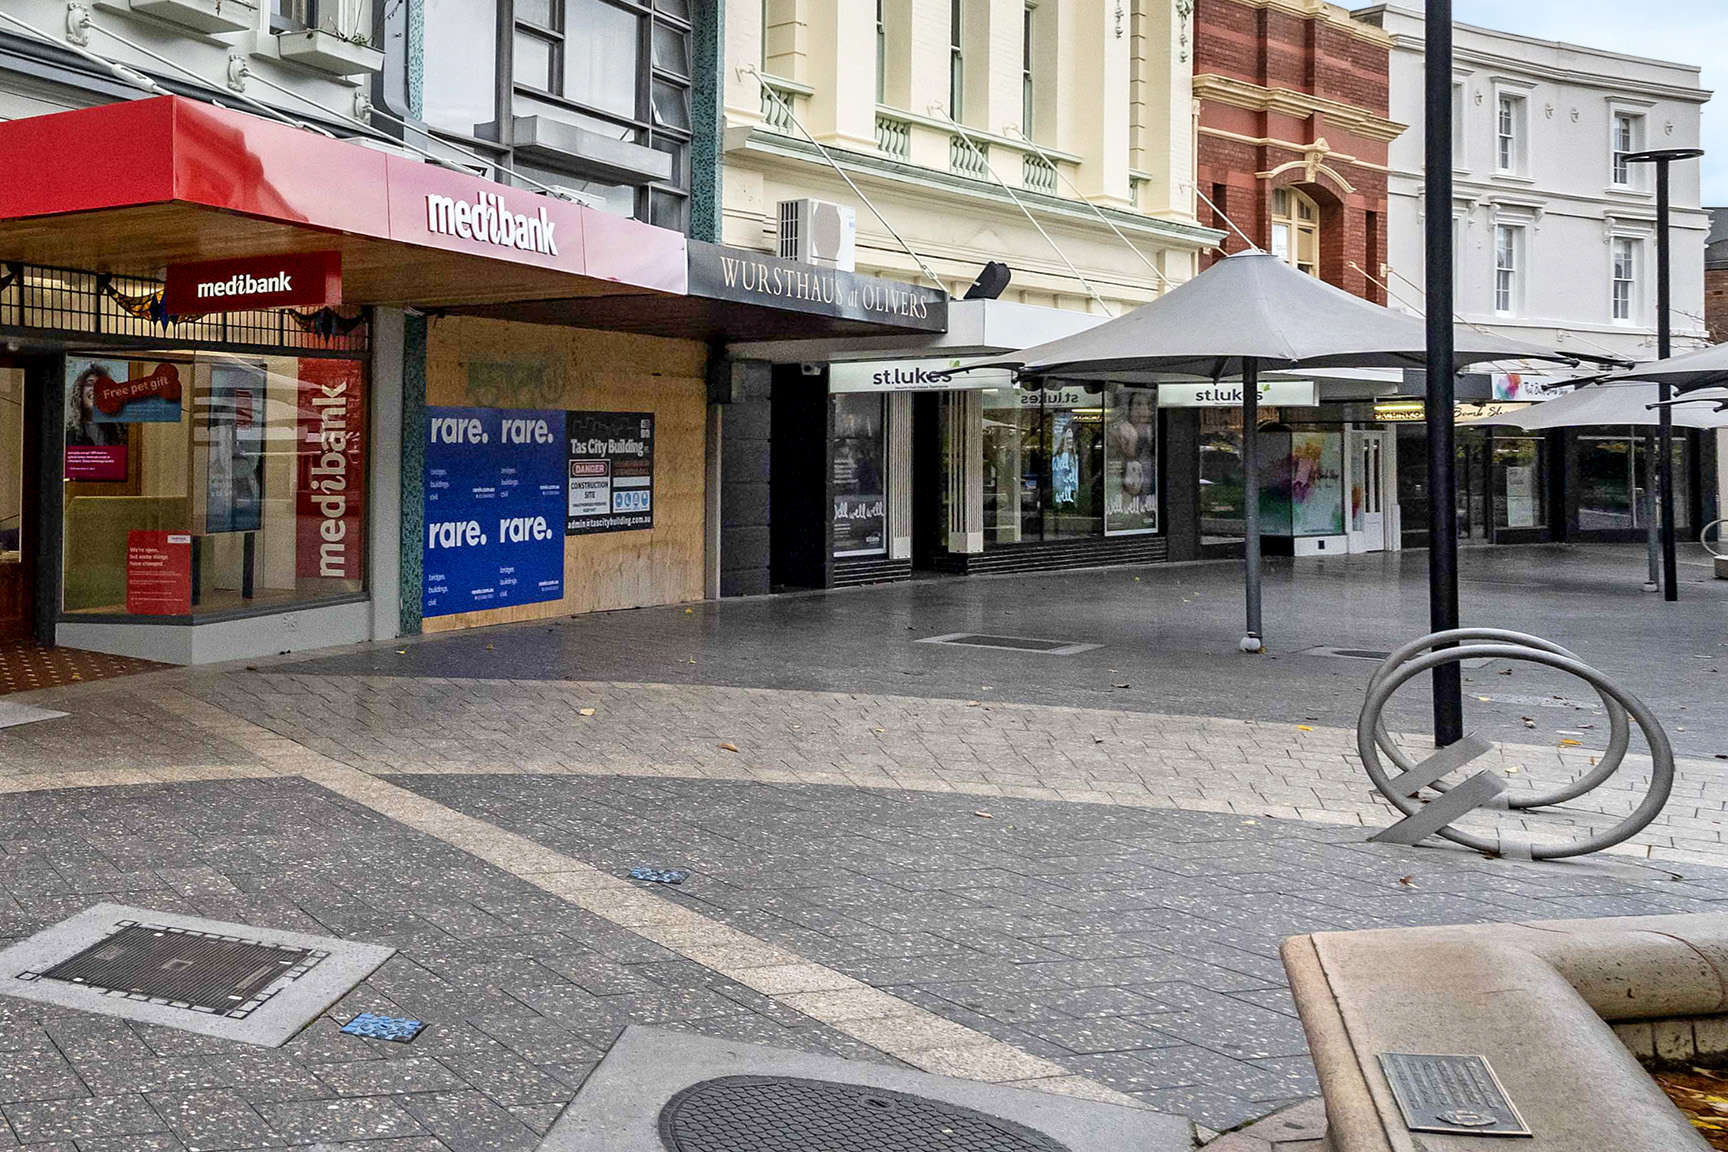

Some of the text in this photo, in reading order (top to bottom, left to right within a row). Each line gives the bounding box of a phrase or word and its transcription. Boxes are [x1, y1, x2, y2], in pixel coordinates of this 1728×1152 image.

[425, 190, 559, 256] medibank
[197, 271, 293, 298] medibank
[720, 256, 928, 319] WURSTHAUS at OLIVERS
[103, 376, 170, 399] Free pet gift
[1195, 388, 1263, 401] st.luks
[431, 418, 489, 443] rare.
[501, 419, 554, 443] rare.
[570, 438, 586, 454] Tas
[587, 438, 607, 457] City
[608, 438, 644, 457] Building
[311, 381, 347, 577] medibank
[575, 464, 605, 474] DANGER
[571, 481, 609, 489] CONSTRUCTION
[584, 491, 596, 499] SITE
[429, 520, 487, 548] rare.
[499, 516, 553, 543] rare.
[567, 516, 651, 529] admin@tascitybuilding.com.au
